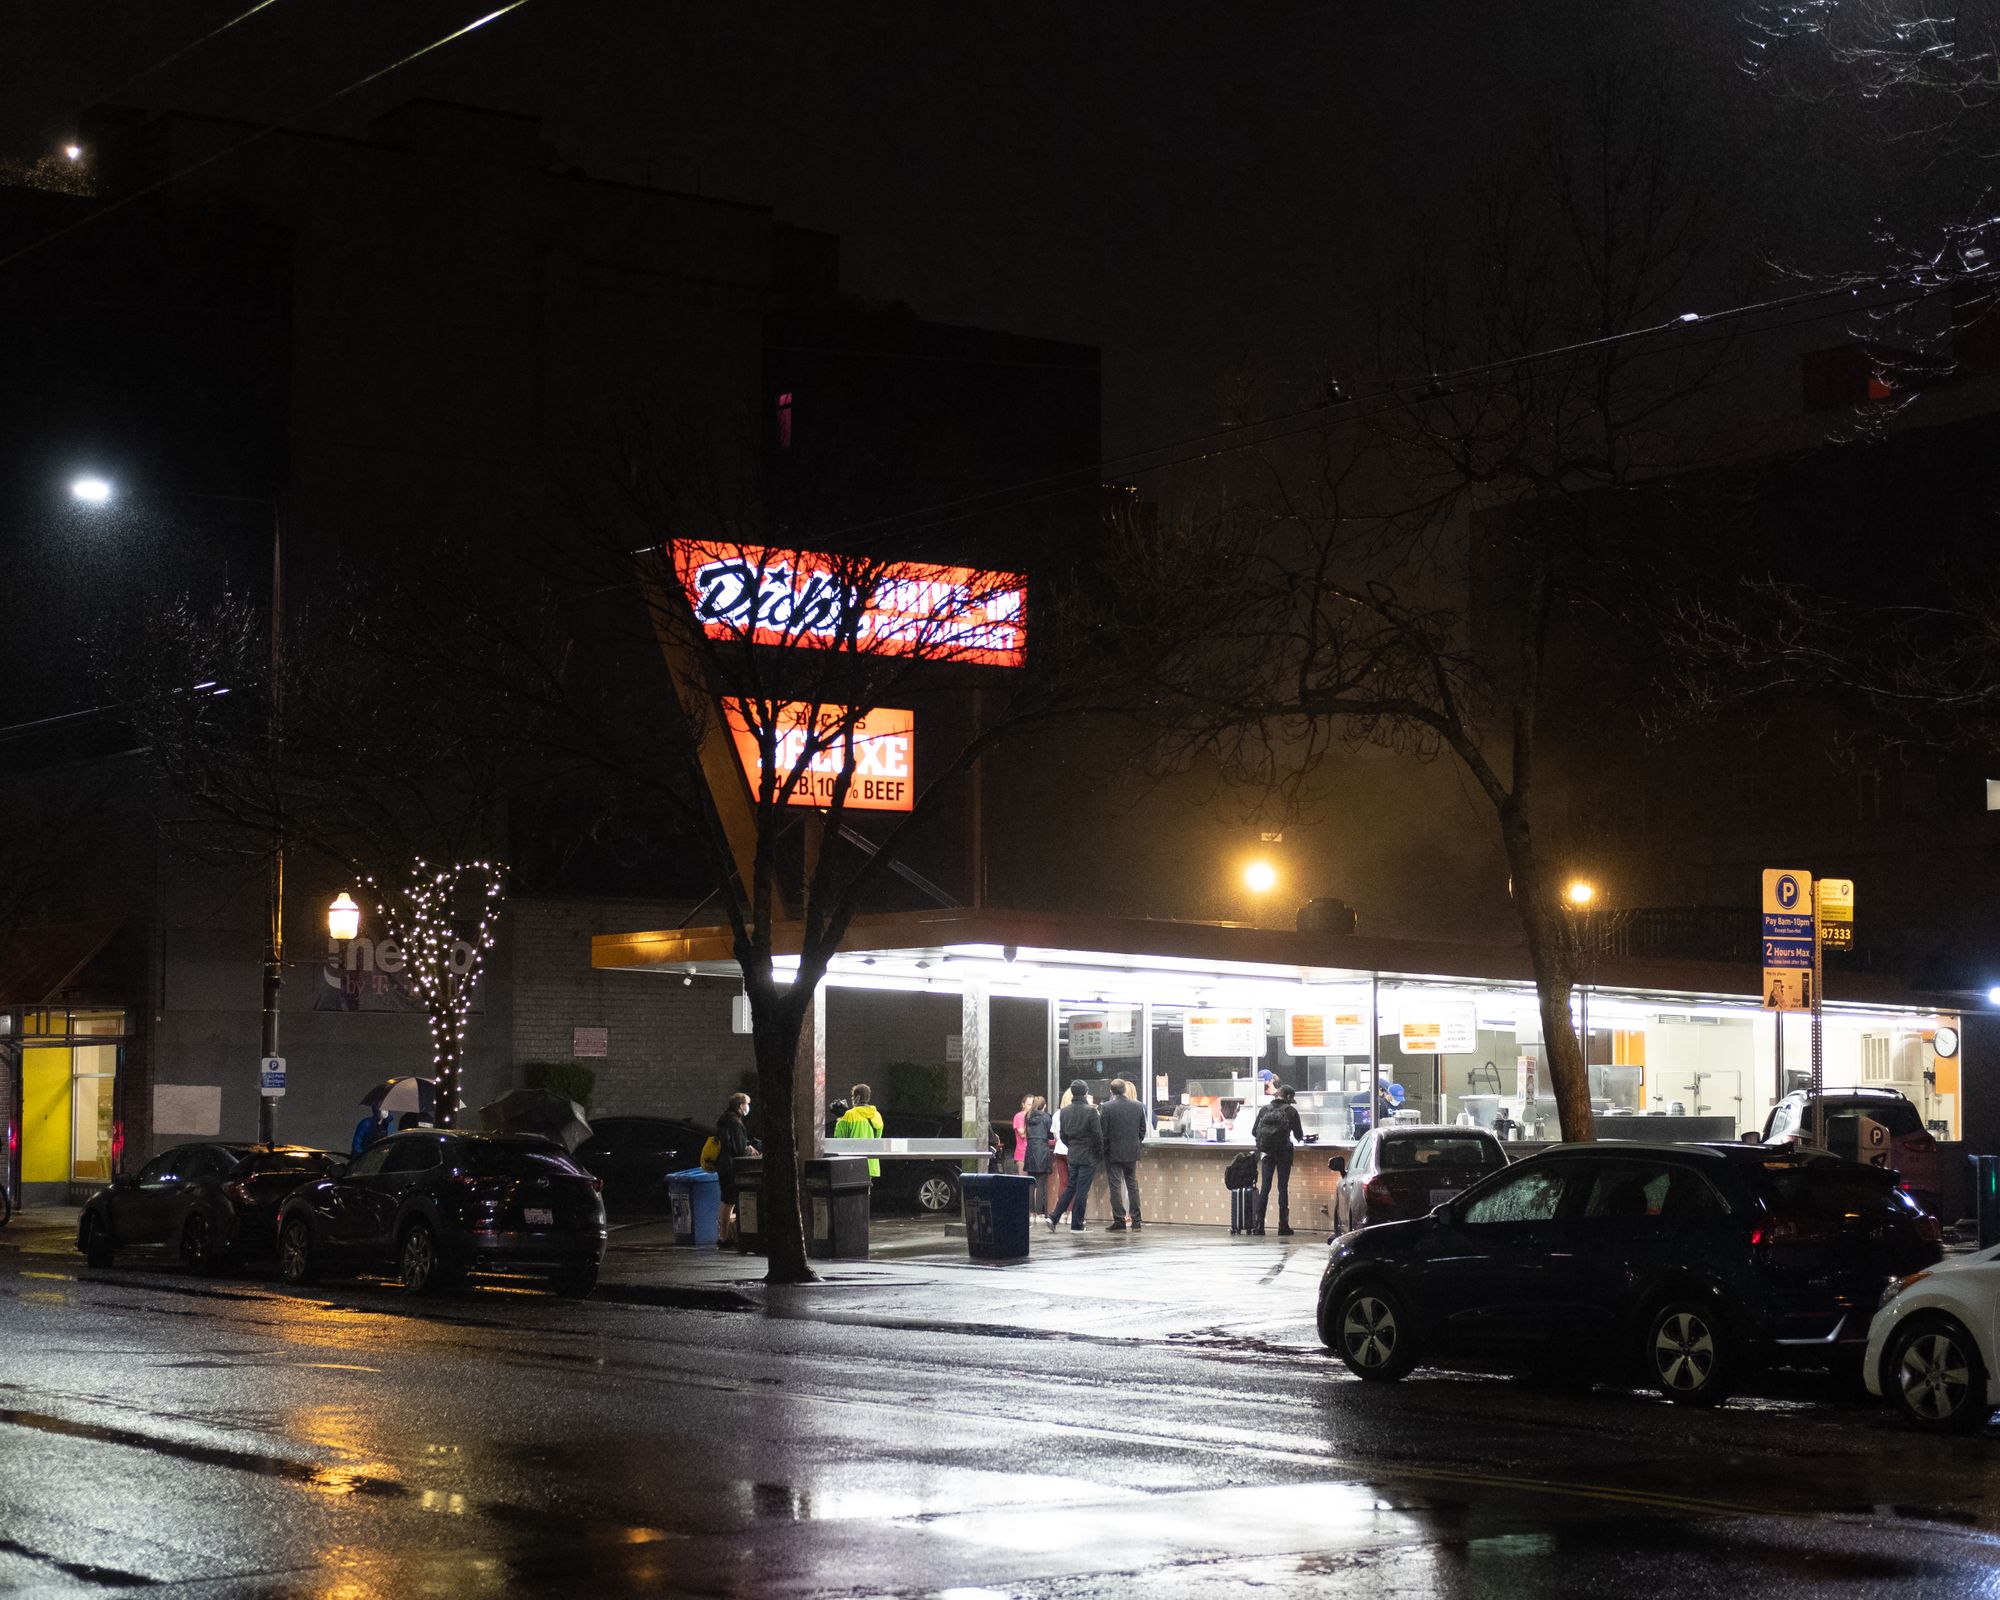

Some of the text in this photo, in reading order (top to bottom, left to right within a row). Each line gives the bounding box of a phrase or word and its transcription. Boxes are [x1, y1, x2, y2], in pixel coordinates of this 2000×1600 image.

[699, 563, 866, 637] Dick
[817, 777, 859, 799] 10%
[864, 780, 905, 801] BEEF
[1783, 882, 1795, 902] P
[1765, 916, 1776, 927] Pay
[1821, 928, 1851, 940] 87333
[327, 937, 475, 974] meo
[1766, 942, 1810, 958] 2 Hours Max
[346, 977, 366, 999] by
